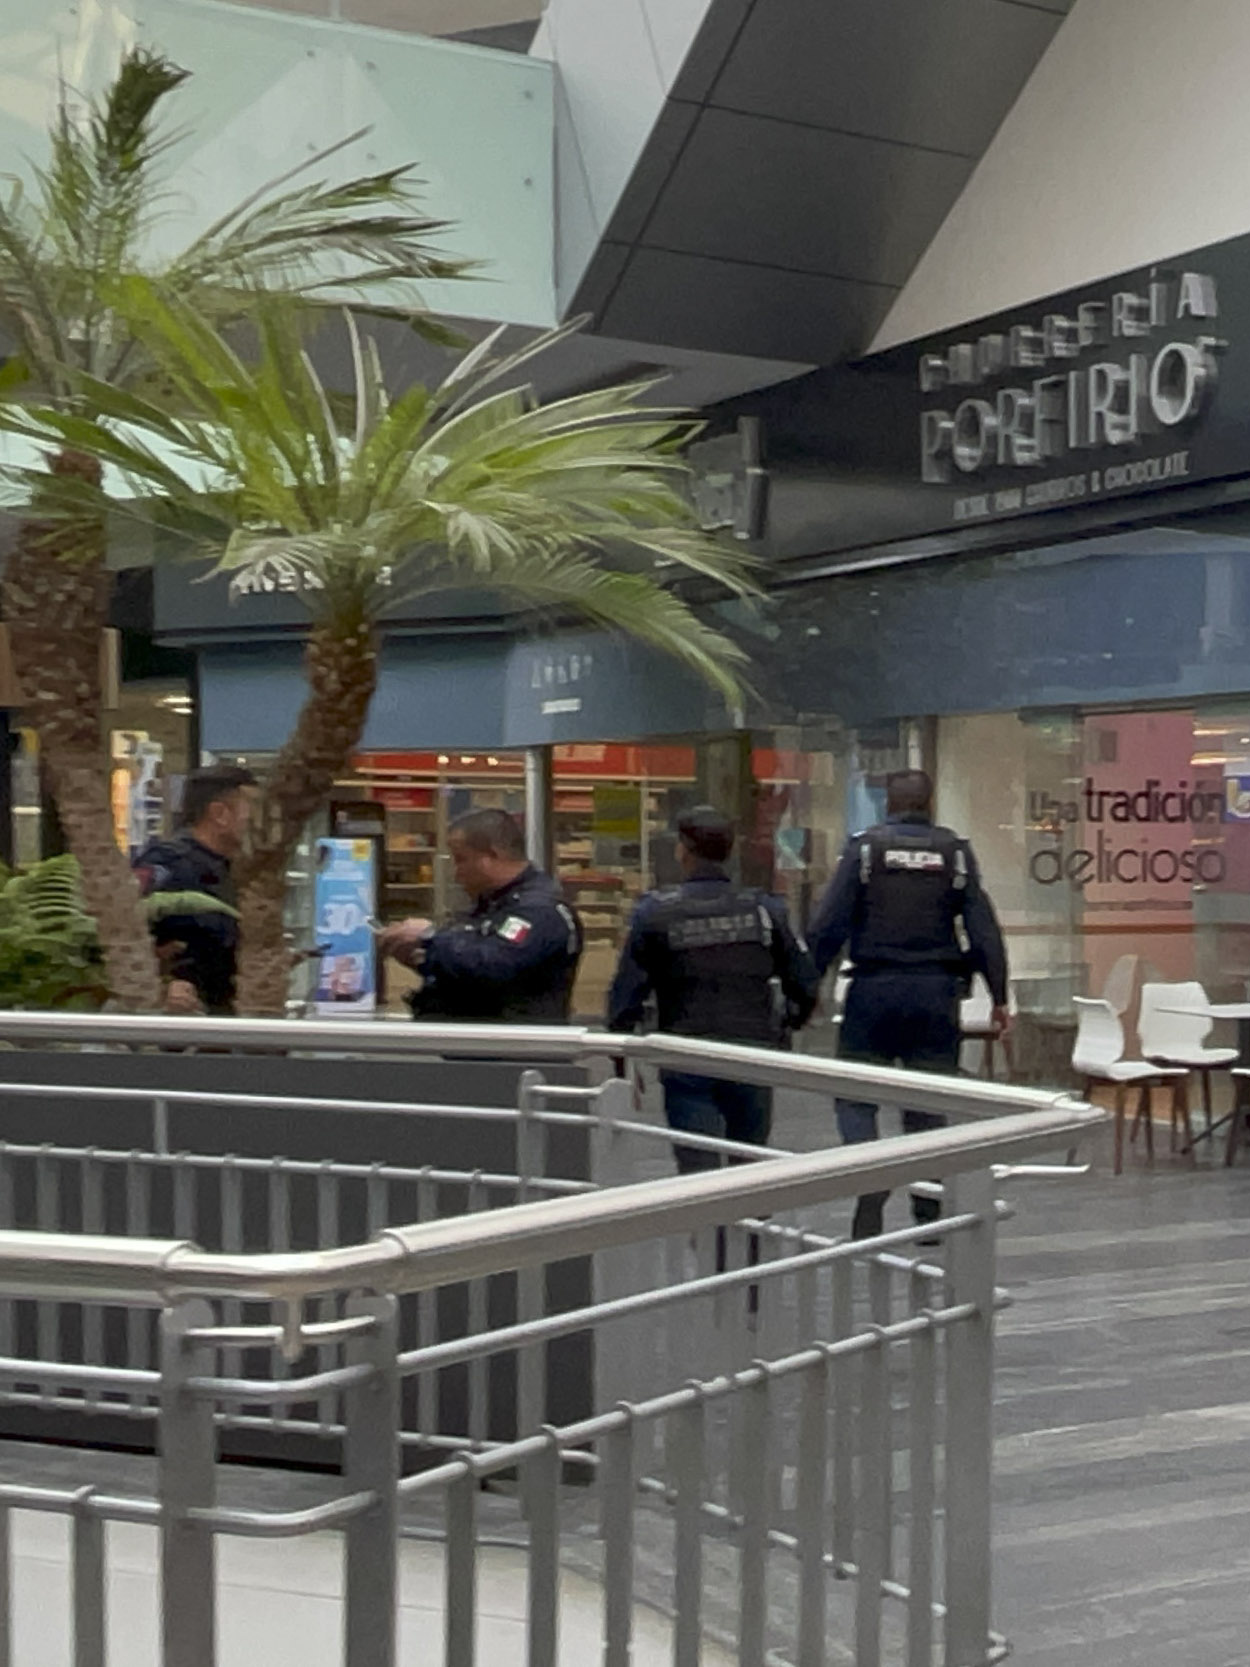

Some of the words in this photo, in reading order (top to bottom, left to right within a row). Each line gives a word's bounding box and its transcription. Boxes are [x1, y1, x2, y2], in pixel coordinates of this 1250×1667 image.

[921, 340, 1208, 484] PORFIRIO
[1082, 777, 1225, 823] tradición
[1029, 830, 1226, 884] delicioso
